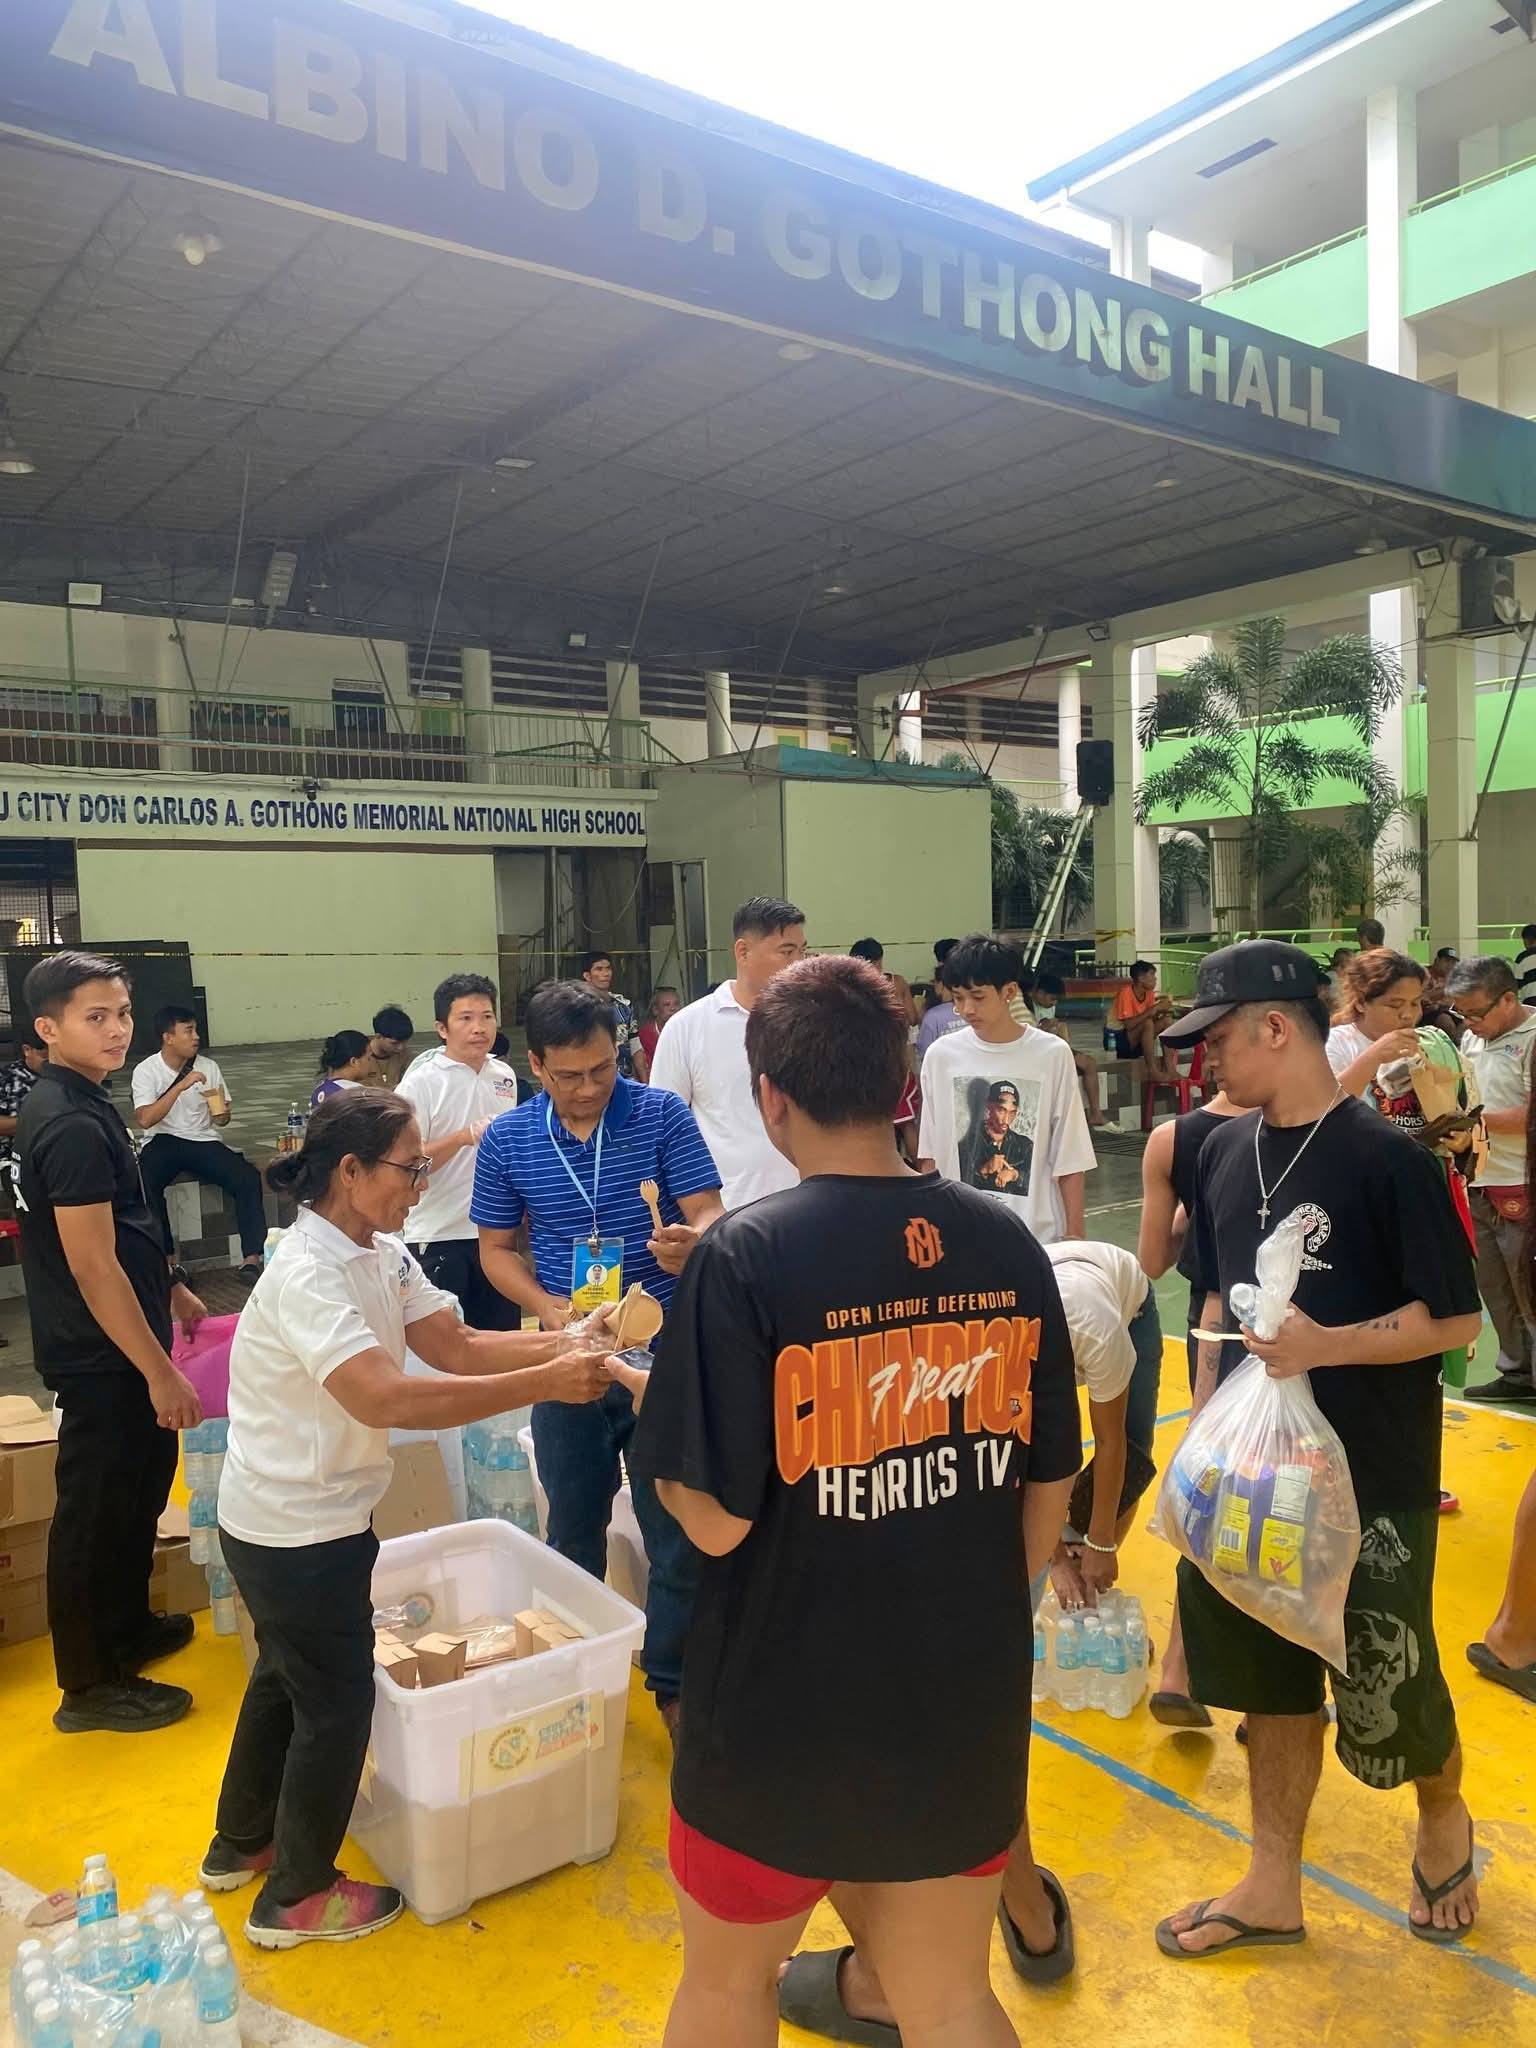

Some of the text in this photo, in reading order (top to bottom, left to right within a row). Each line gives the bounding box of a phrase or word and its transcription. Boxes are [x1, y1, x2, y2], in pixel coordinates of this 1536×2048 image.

[49, 0, 1341, 436] ALBINO D. GOTHONG HALL
[17, 791, 72, 823] CITY
[79, 793, 127, 824] DON
[133, 795, 219, 826] CARLOS
[224, 799, 244, 827] A.
[250, 800, 348, 829] GOTHONG
[354, 803, 449, 831] MEMORIAL
[454, 806, 538, 832] NATIONAL
[542, 808, 581, 833] HIGH
[585, 810, 645, 835] SCHOOL
[826, 1306, 872, 1330] OPEN
[938, 1290, 1016, 1313] DEFENDING
[817, 1447, 958, 1521] HENRICS
